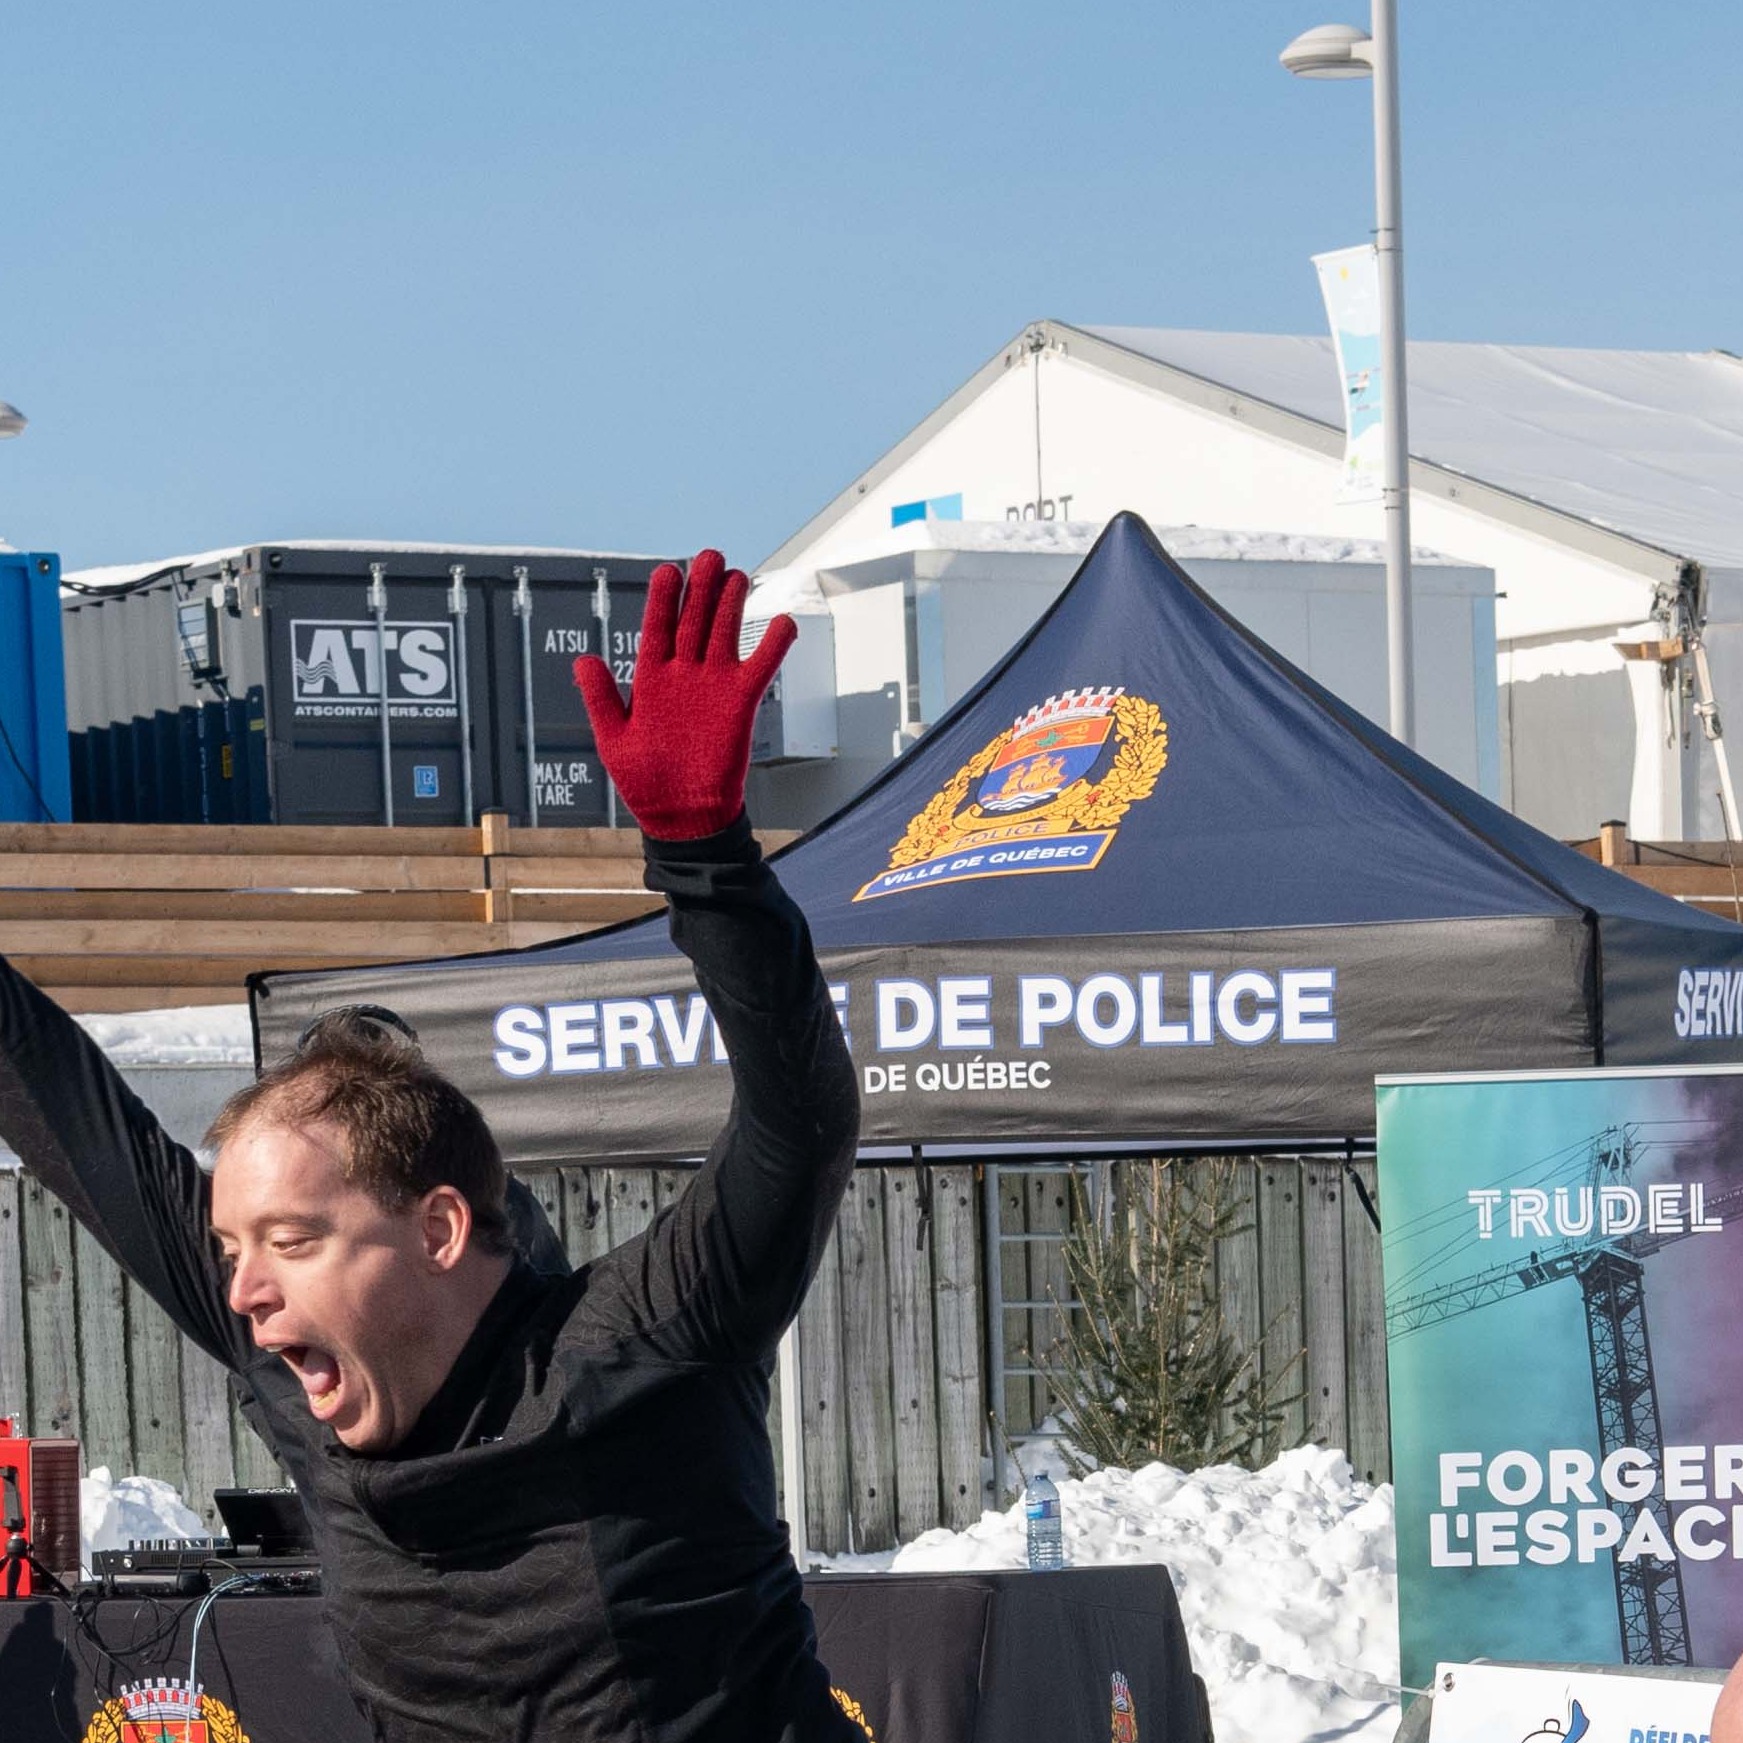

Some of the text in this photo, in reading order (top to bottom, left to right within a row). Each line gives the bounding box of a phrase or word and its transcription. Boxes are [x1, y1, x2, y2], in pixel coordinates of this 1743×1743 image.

[544, 628, 589, 654] ATSU
[302, 628, 449, 696] ATS
[294, 705, 458, 718] ATSCONTAIERS.COM
[533, 761, 593, 785] MAX.GR.
[534, 784, 575, 806] TARE
[953, 821, 1050, 849] POLICE
[883, 844, 1089, 887] VILLE DE QUÉBEC
[875, 975, 996, 1052] DE
[1020, 966, 1338, 1050] POLICE
[863, 1057, 1052, 1095] DE QUÉBEC
[1467, 1182, 1724, 1240] TRUDEL
